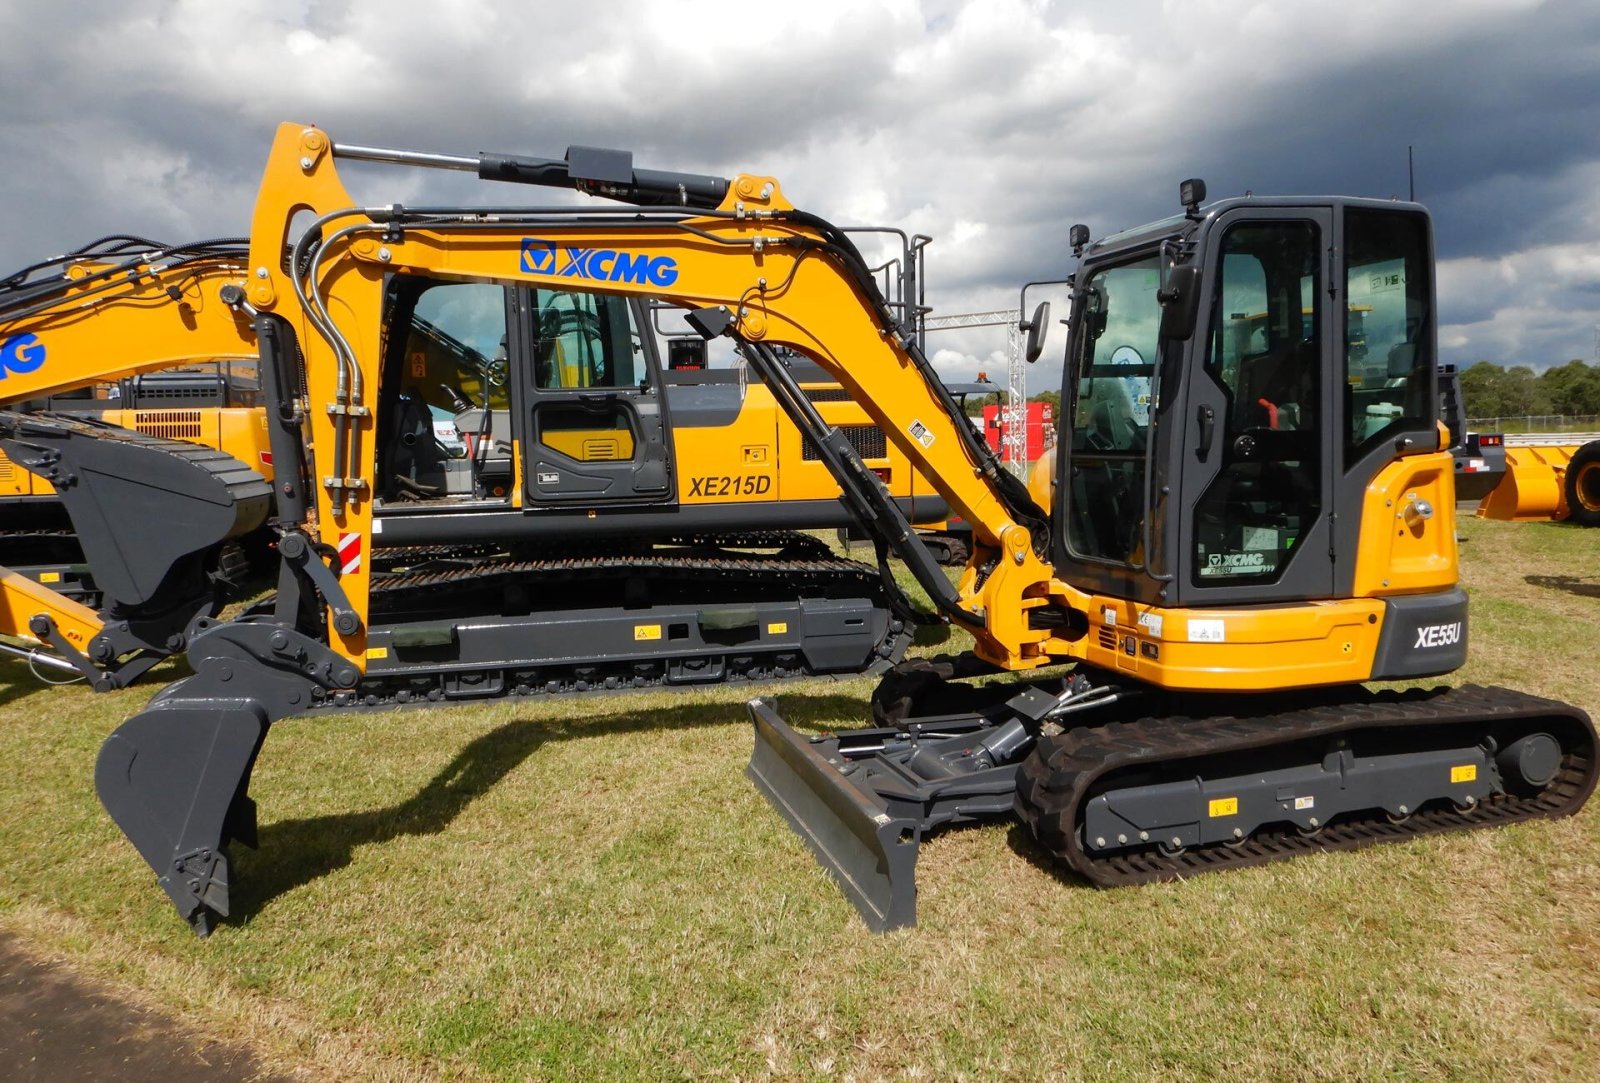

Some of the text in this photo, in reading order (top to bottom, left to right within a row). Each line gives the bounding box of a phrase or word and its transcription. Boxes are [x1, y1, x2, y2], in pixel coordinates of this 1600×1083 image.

[556, 246, 679, 287] XCMG
[688, 475, 771, 497] XE215D
[1222, 553, 1264, 566] XCMG
[1413, 621, 1461, 648] XE55U
